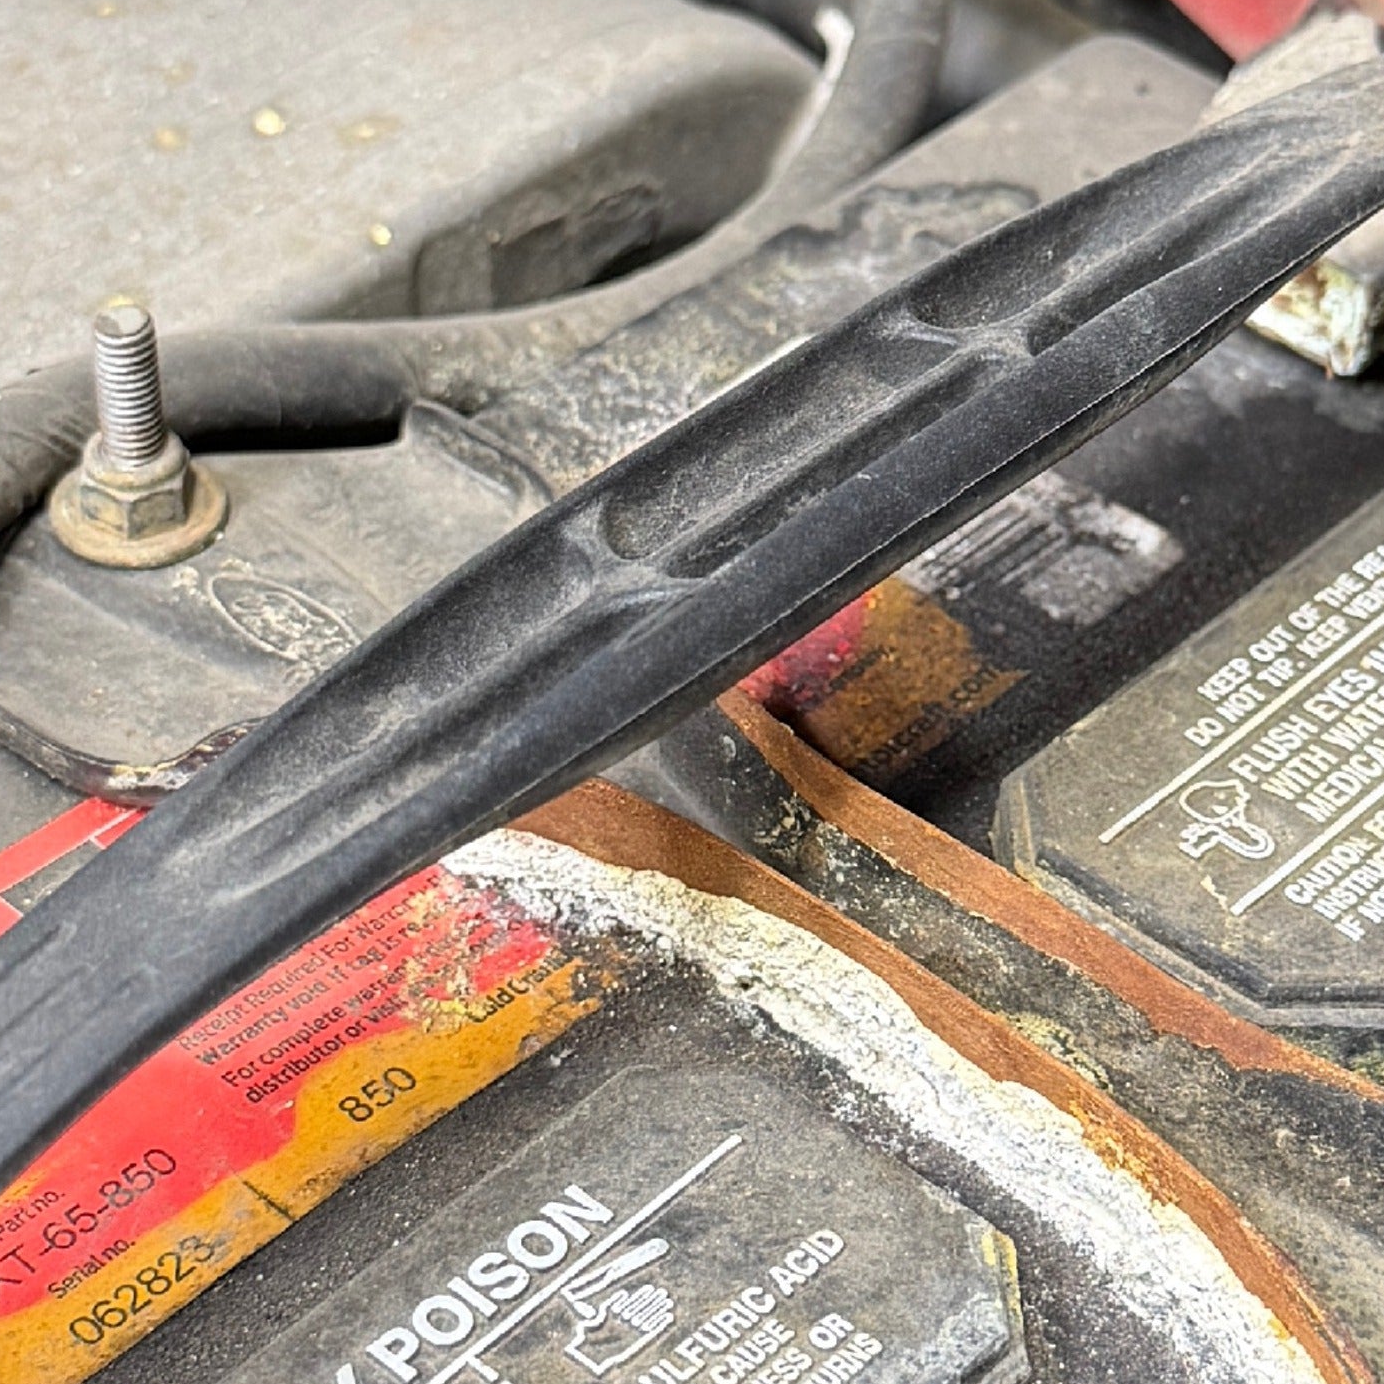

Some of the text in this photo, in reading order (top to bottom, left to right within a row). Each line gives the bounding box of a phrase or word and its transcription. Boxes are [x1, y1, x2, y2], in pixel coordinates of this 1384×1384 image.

[1197, 656, 1251, 702] KEEP
[1248, 624, 1296, 661] OUT
[1287, 601, 1322, 632] OF
[1314, 571, 1365, 608] THE
[1184, 716, 1225, 749] DO
[1215, 687, 1266, 726] NOT
[1297, 613, 1351, 659] KEEP
[1228, 714, 1318, 783] FLUSH
[1303, 668, 1377, 722] EYES
[1261, 744, 1339, 801] WITH
[1334, 913, 1366, 943] IF
[178, 999, 247, 1053] Receipt
[243, 952, 326, 1011] Required
[323, 930, 355, 961] For
[196, 1006, 289, 1066] Warranty
[285, 978, 331, 1011] void
[347, 946, 385, 978] tag
[385, 935, 401, 959] is
[221, 1056, 264, 1090] For
[261, 1005, 345, 1067] complete
[245, 1030, 342, 1104] distributor
[339, 1016, 368, 1040] or
[338, 1066, 418, 1123] 850
[34, 1188, 66, 1213] no.
[48, 1235, 136, 1300] Serial no.
[68, 1235, 216, 1345] 062823
[366, 1184, 615, 1384] POISON
[768, 1228, 845, 1297] ACID
[808, 1312, 855, 1350] OR
